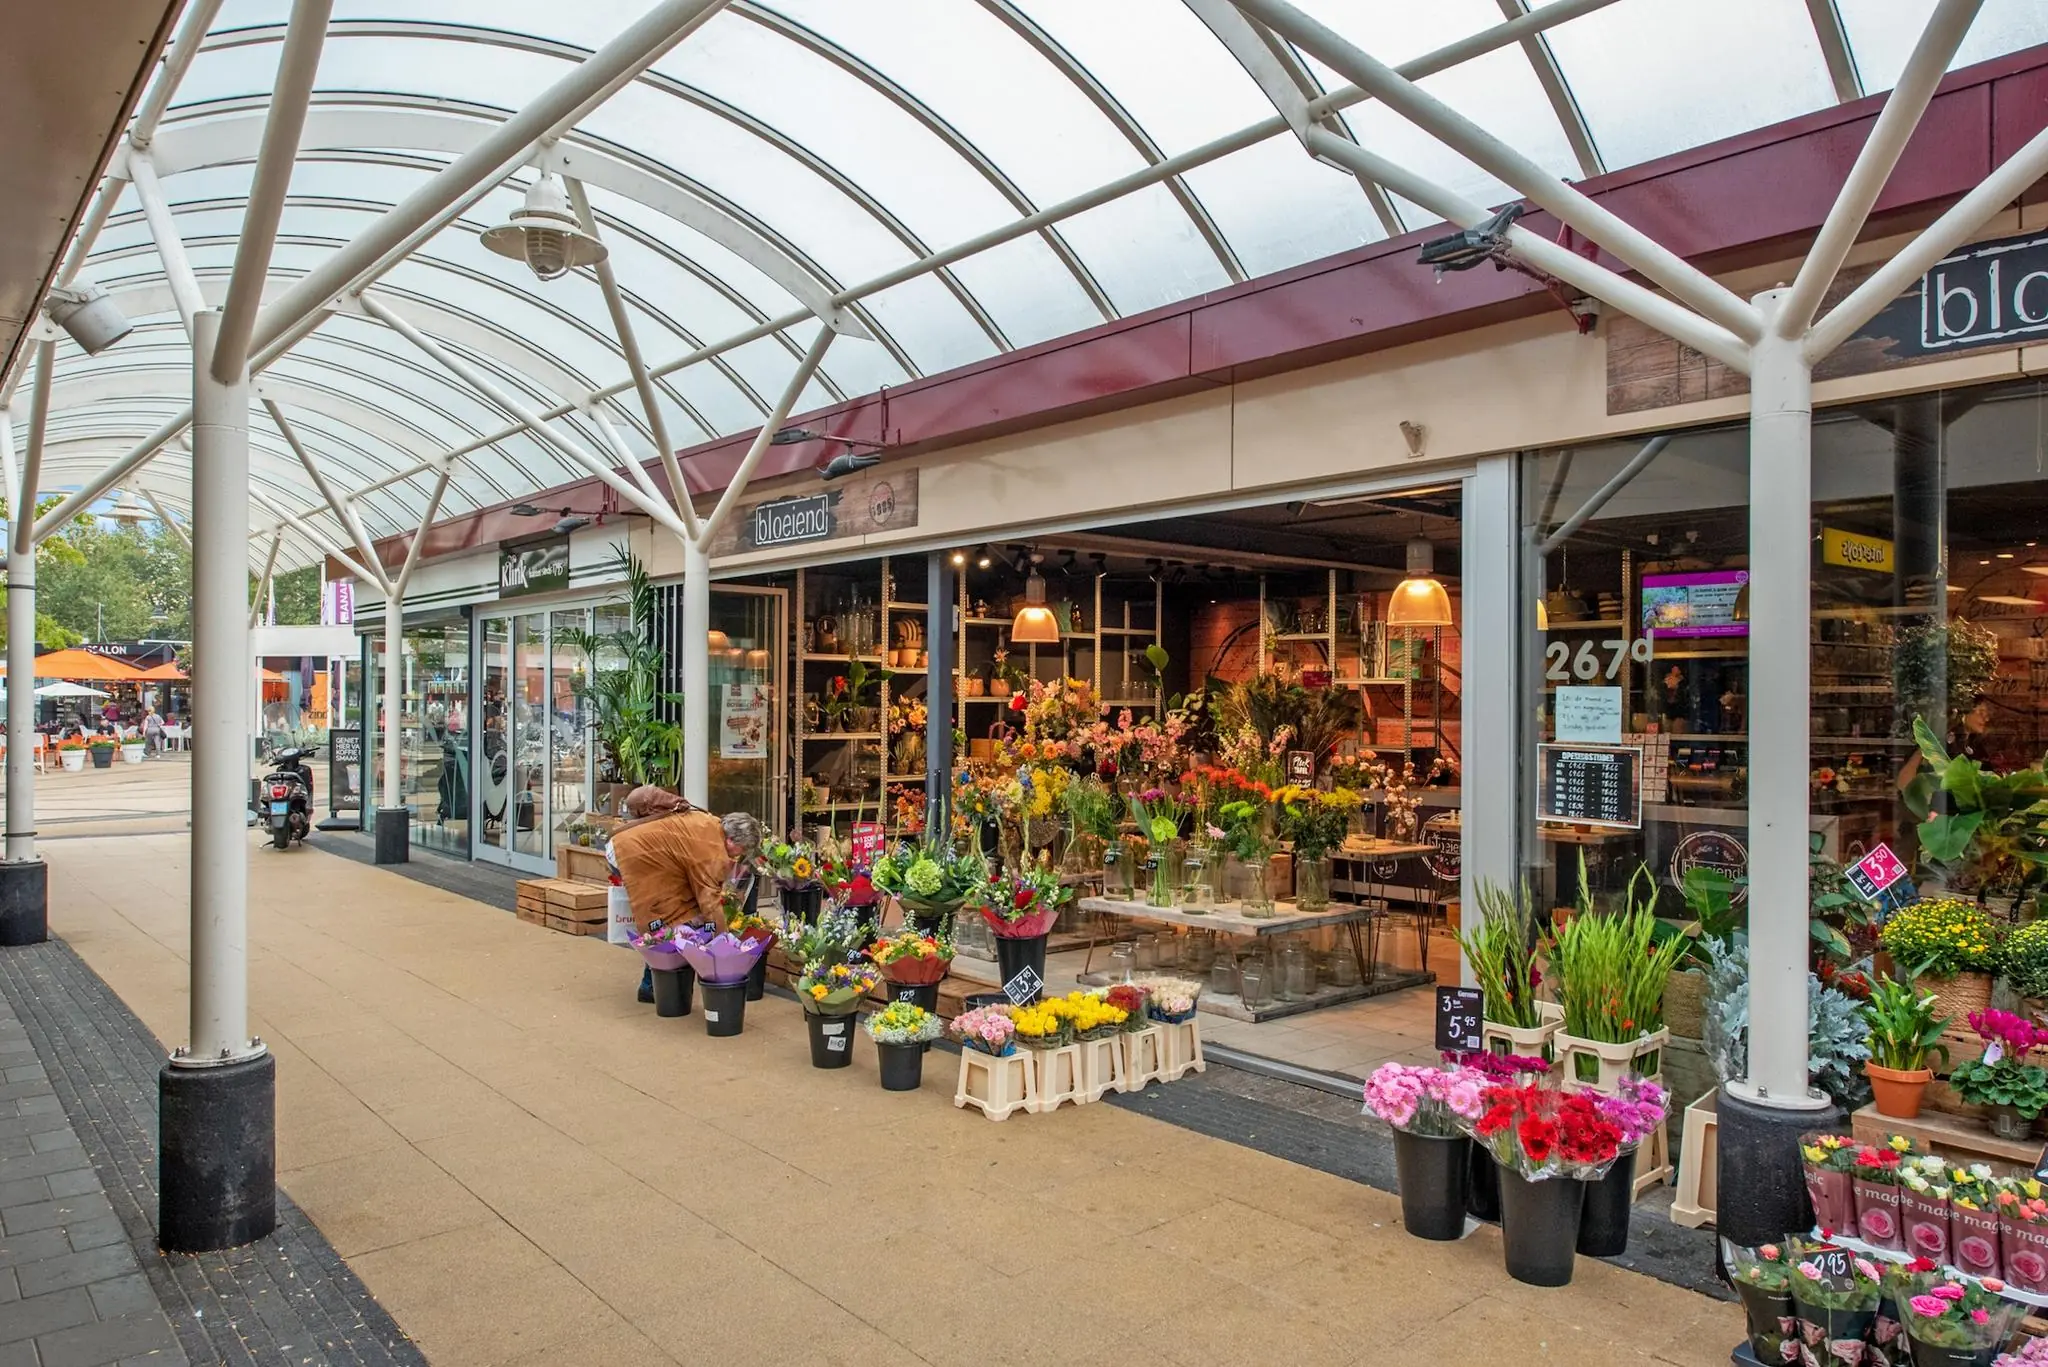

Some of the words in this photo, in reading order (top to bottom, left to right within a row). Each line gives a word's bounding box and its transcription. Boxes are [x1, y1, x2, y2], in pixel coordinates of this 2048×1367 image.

[757, 498, 826, 542] bloeiend
[501, 557, 529, 588] Klink
[84, 645, 127, 655] SSALON
[1442, 996, 1452, 1012] 3
[1804, 1168, 1824, 1185] gic
